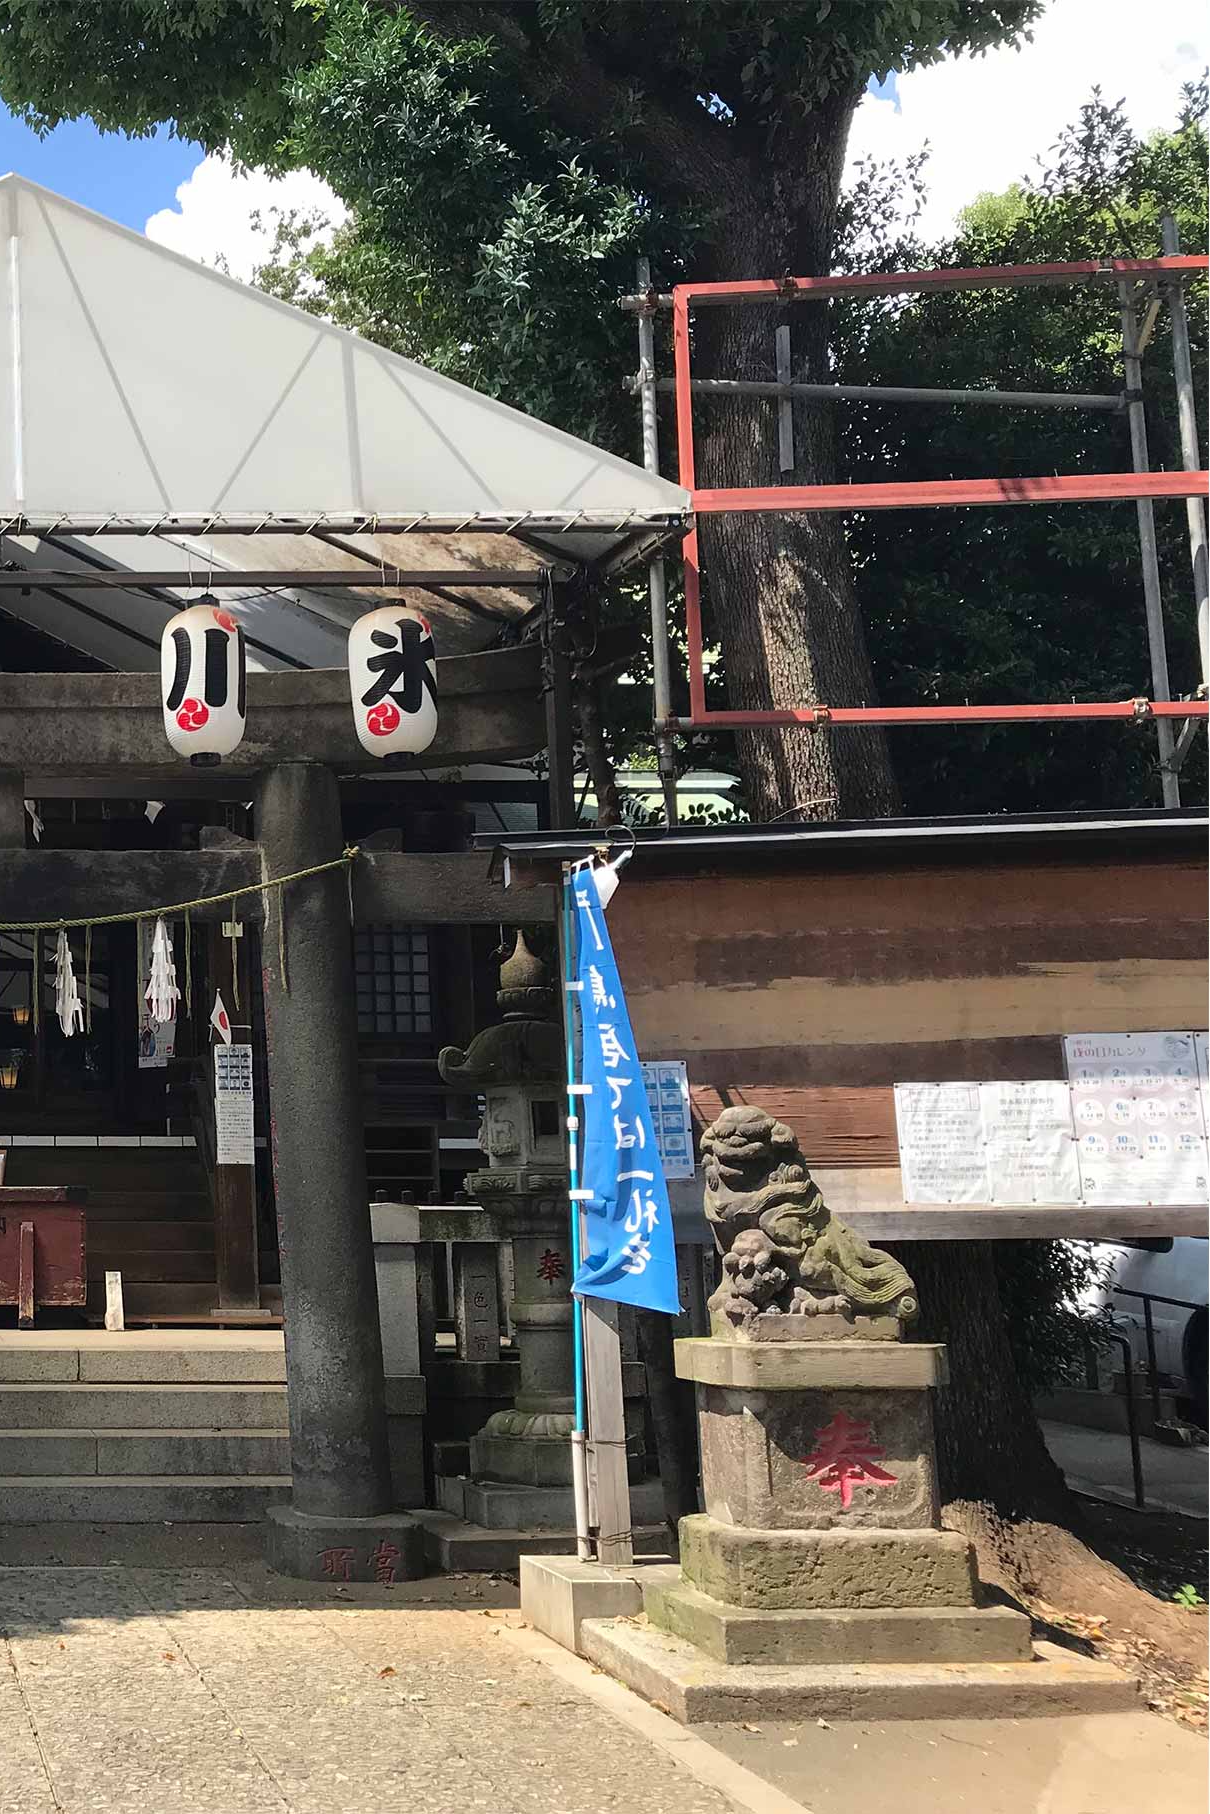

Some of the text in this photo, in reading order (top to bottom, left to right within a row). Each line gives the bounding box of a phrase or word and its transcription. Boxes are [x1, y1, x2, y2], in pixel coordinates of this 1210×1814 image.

[166, 624, 246, 719] 川
[361, 618, 437, 714] 氷
[800, 1409, 899, 1511] 奉
